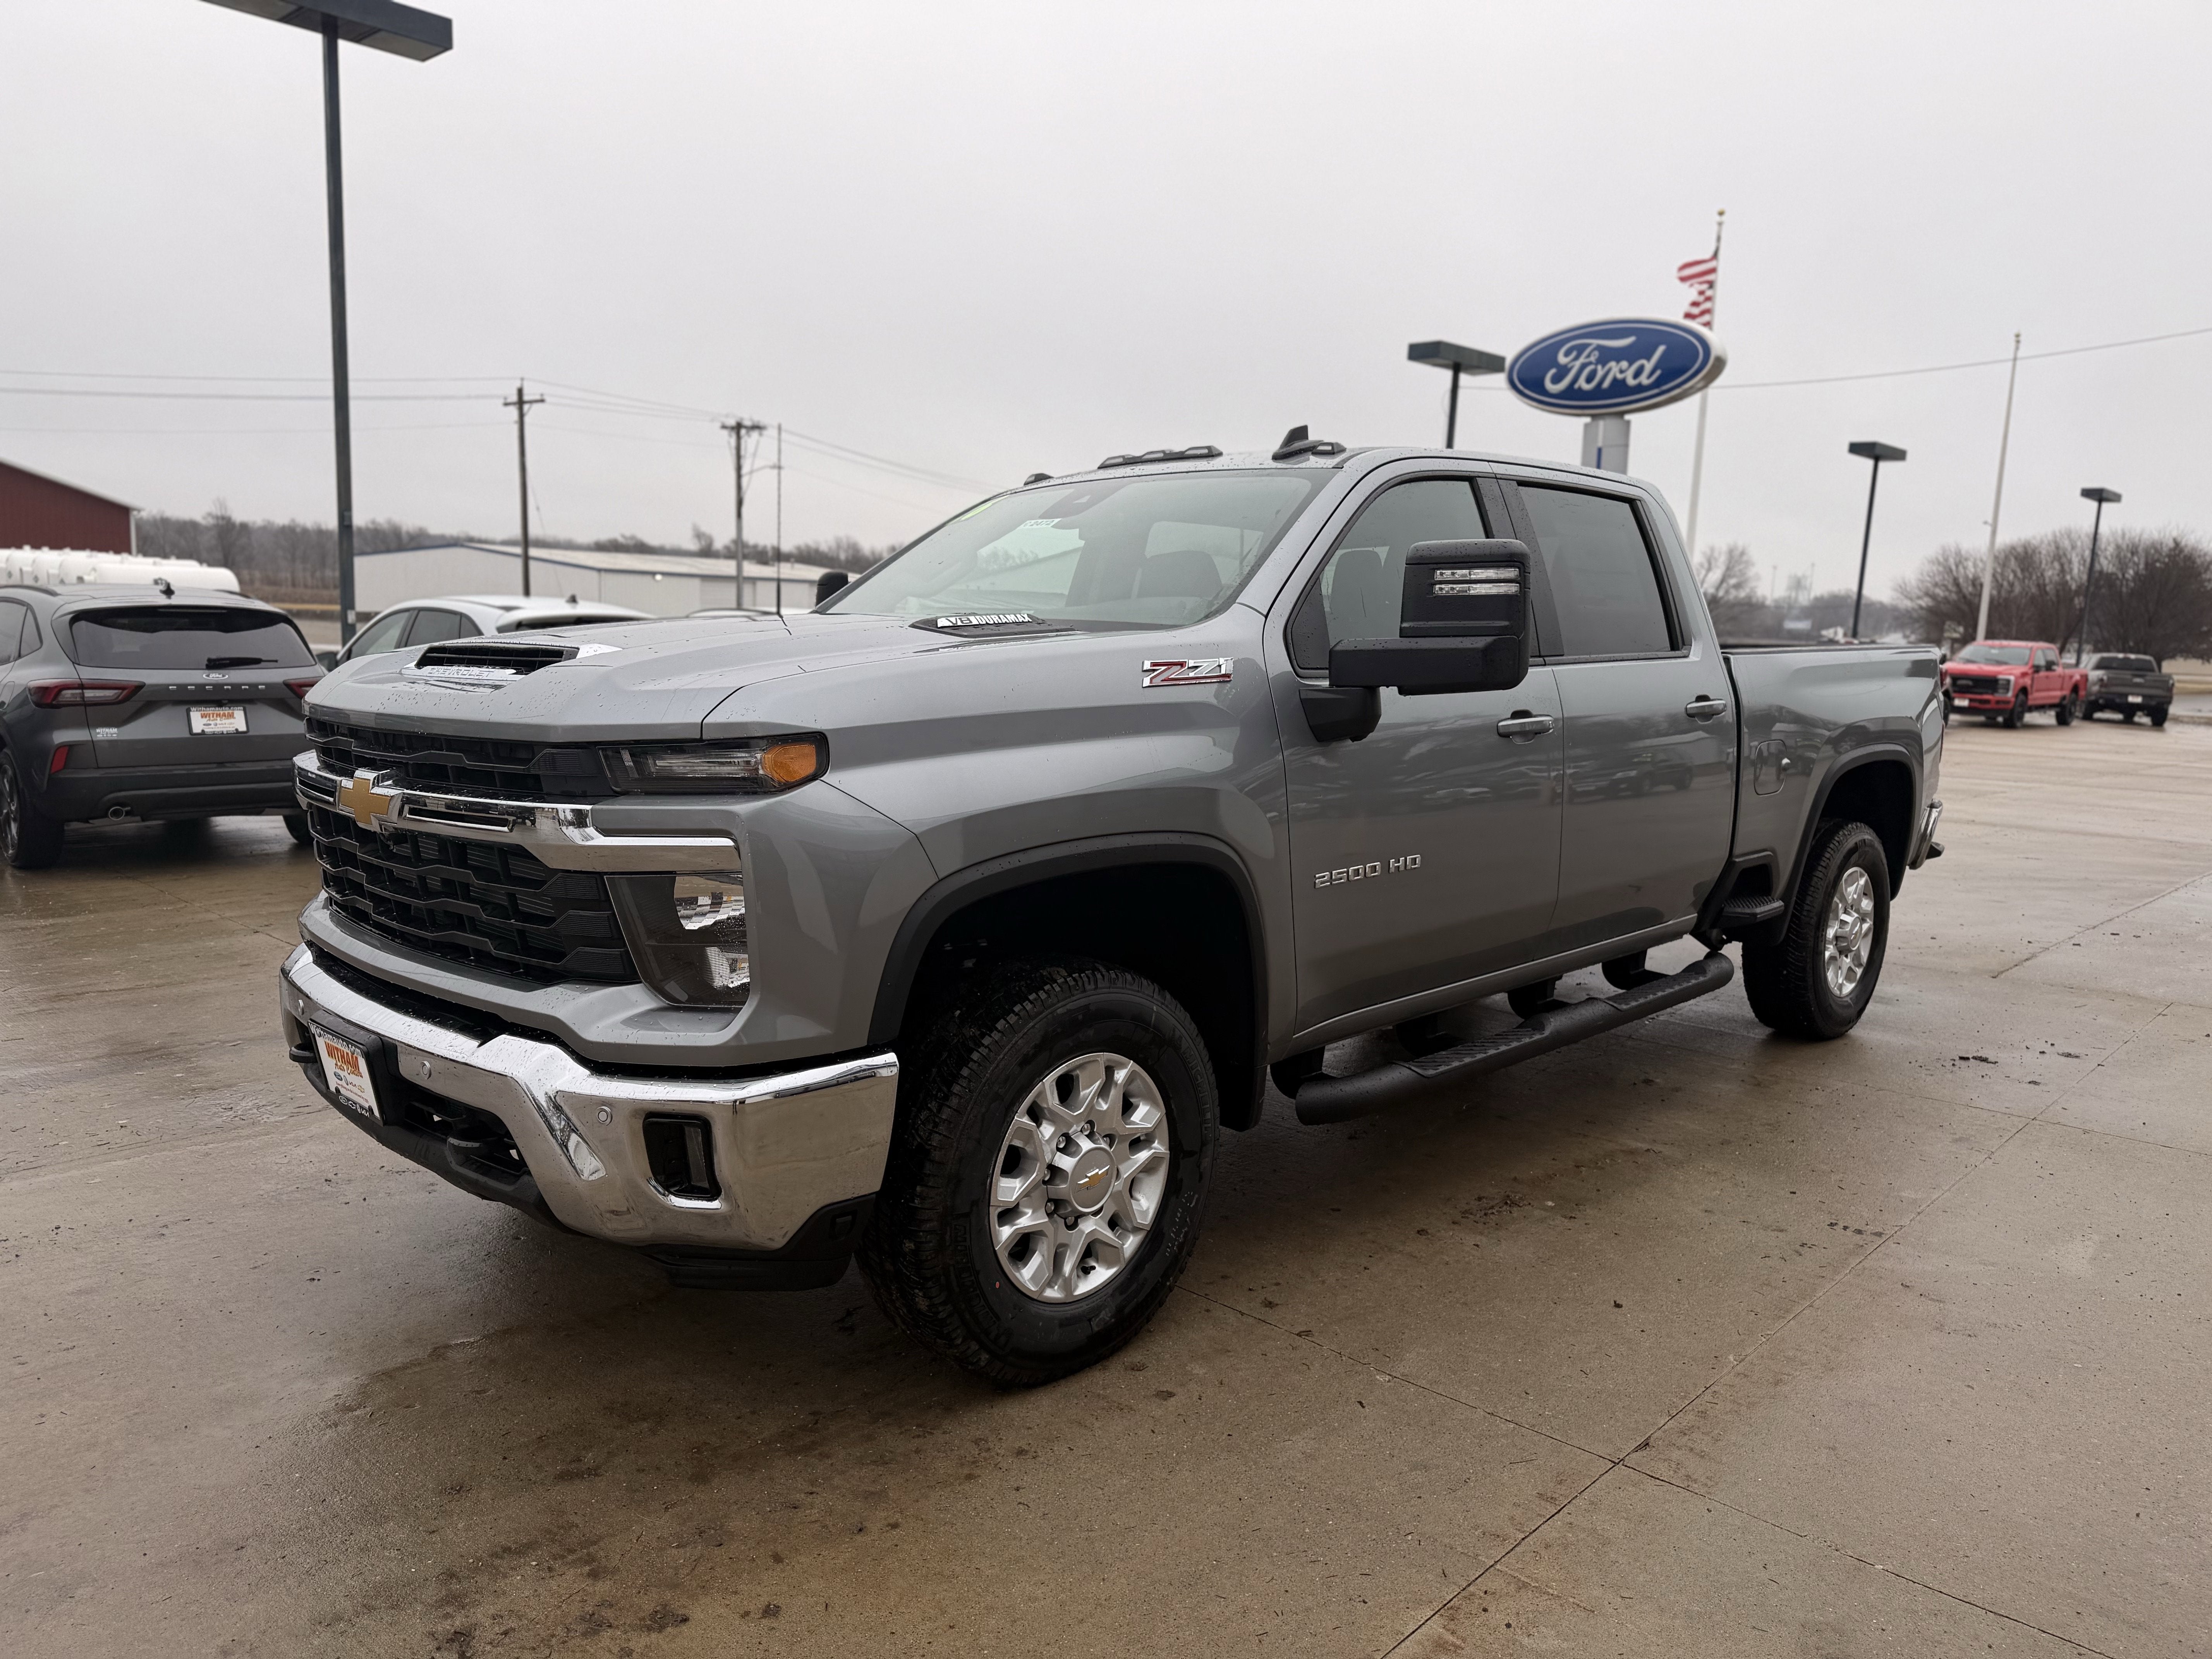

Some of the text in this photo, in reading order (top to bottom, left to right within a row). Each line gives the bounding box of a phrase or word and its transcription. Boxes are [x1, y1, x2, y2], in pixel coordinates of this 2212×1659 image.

[1544, 336, 1666, 394] Ford
[945, 614, 1032, 625] V8 DURAMAX
[428, 668, 494, 678] CHEVROLET
[1142, 657, 1233, 688] Z71
[1315, 854, 1421, 888] 2500 HD
[309, 1022, 364, 1058] Withamauto.com
[325, 1041, 360, 1072] WITHAM
